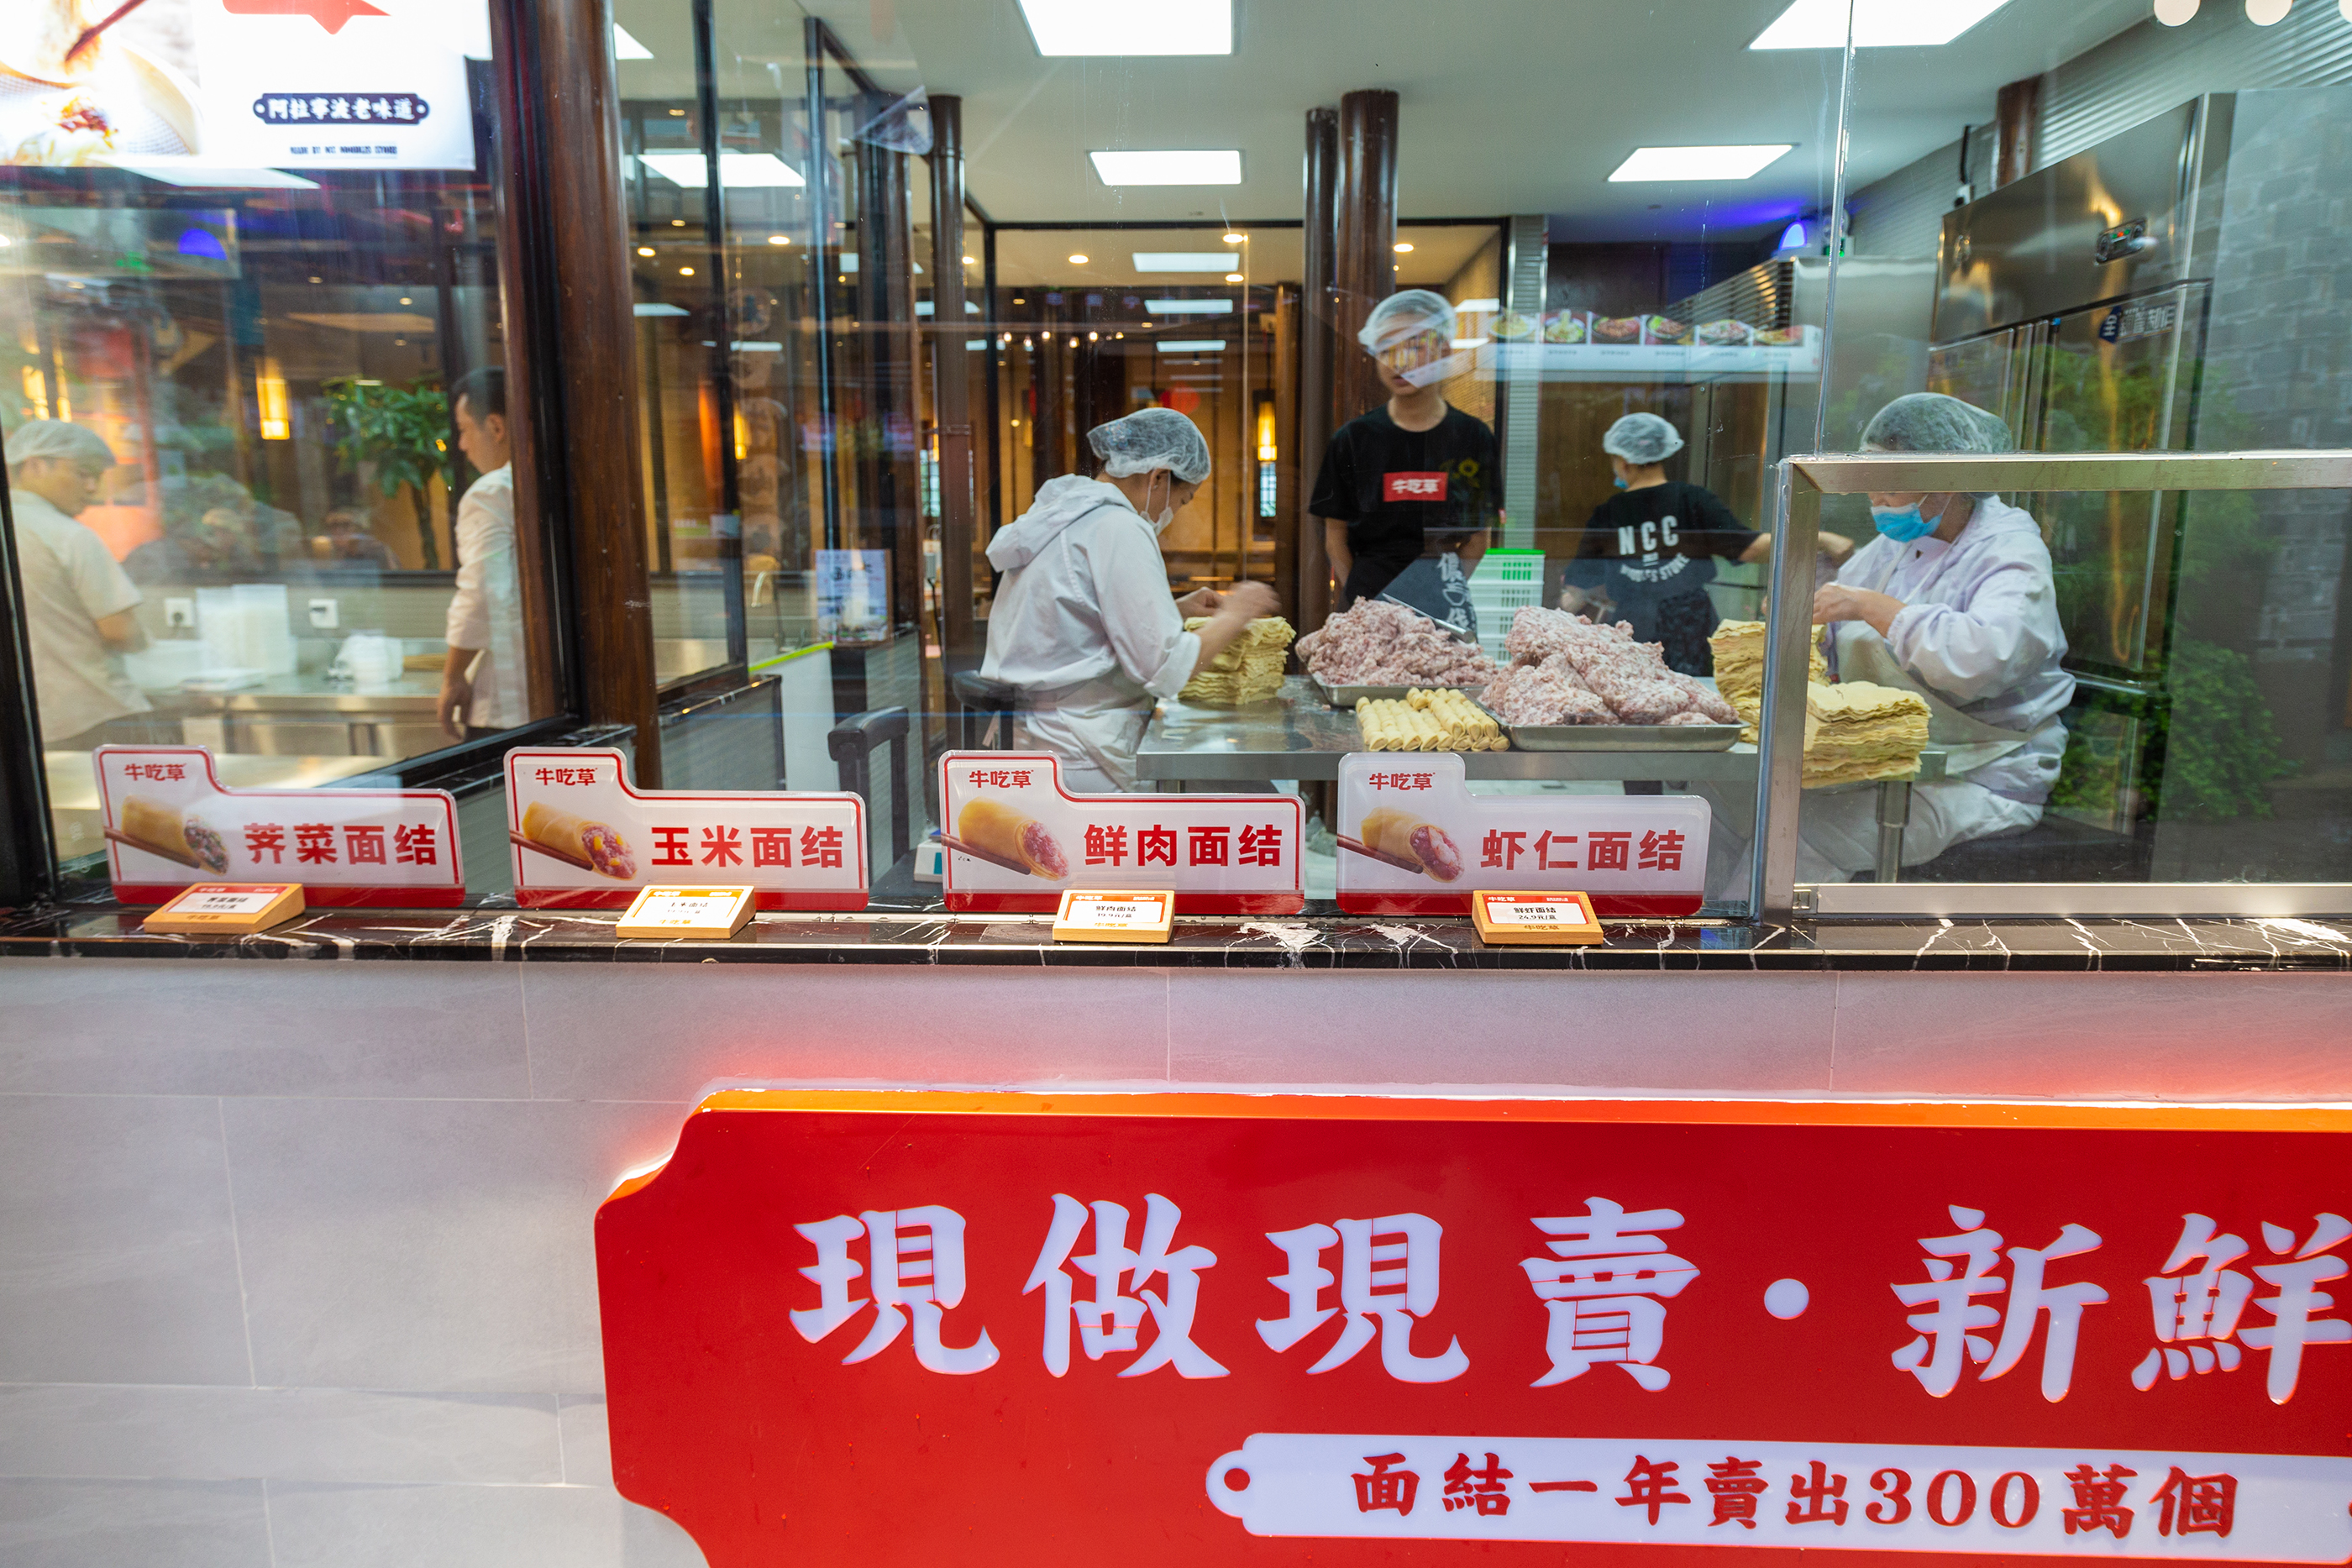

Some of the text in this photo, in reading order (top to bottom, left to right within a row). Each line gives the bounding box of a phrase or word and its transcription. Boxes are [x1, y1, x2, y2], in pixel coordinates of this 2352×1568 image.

[1391, 478, 1440, 494] 牛吃草
[1618, 515, 1679, 555] NCC
[124, 763, 186, 782] 牛吃草
[535, 767, 597, 786] 牛吃草
[969, 769, 1032, 789] 牛吃草
[1368, 772, 1435, 791] 牛吃草
[243, 822, 437, 865] 荠菜面结
[651, 825, 843, 868] 玉米面结
[1084, 823, 1283, 867] 鲜肉面结
[1480, 829, 1686, 872] 虾仁面结
[1351, 1451, 2239, 1540] 面結一年賣出300萬個
